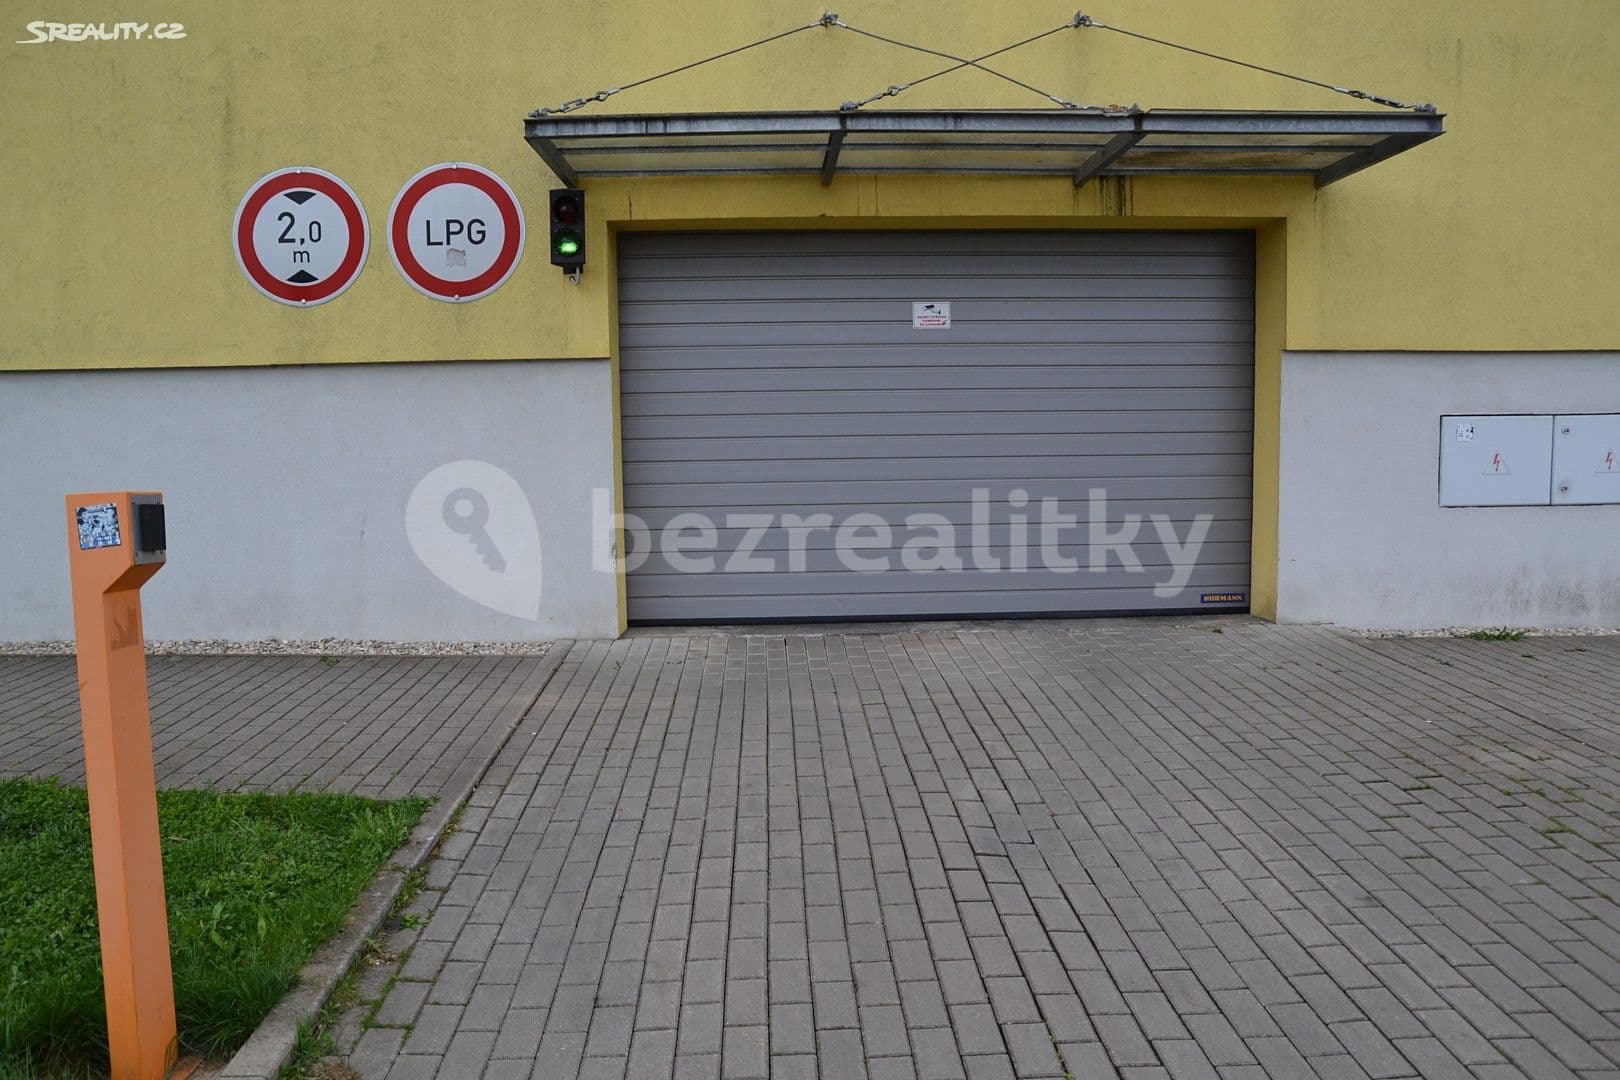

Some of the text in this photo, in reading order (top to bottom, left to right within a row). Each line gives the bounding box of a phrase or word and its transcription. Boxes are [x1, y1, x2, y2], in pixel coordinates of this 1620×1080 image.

[277, 211, 321, 245] 2,0
[426, 218, 486, 246] LPG
[293, 250, 310, 263] m
